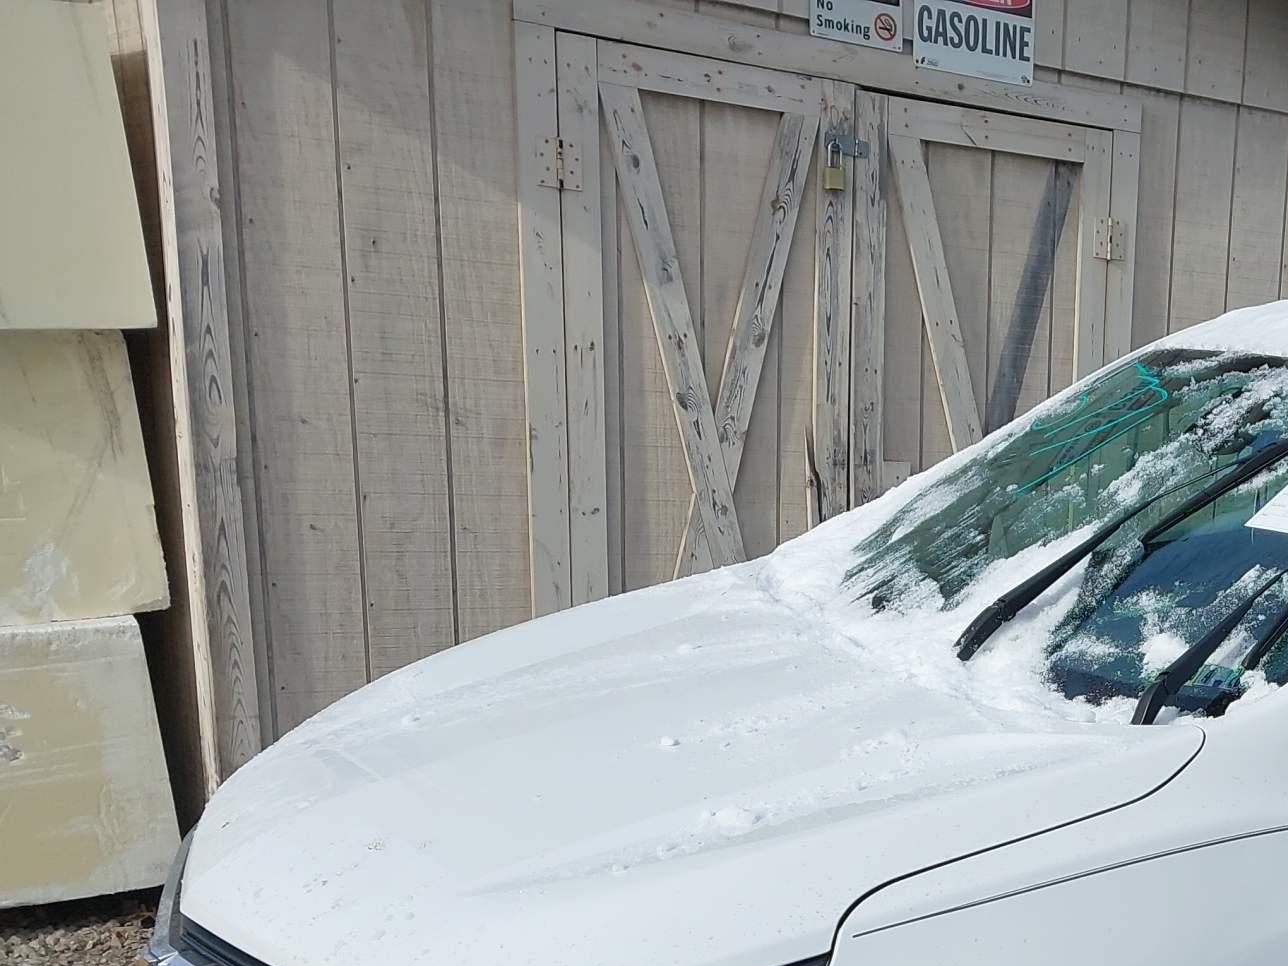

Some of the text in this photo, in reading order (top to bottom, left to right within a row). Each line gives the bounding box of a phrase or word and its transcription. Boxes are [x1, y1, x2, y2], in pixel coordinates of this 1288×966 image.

[816, 0, 833, 11] No
[816, 14, 871, 40] Smoking
[917, 4, 1031, 62] GASOLINE
